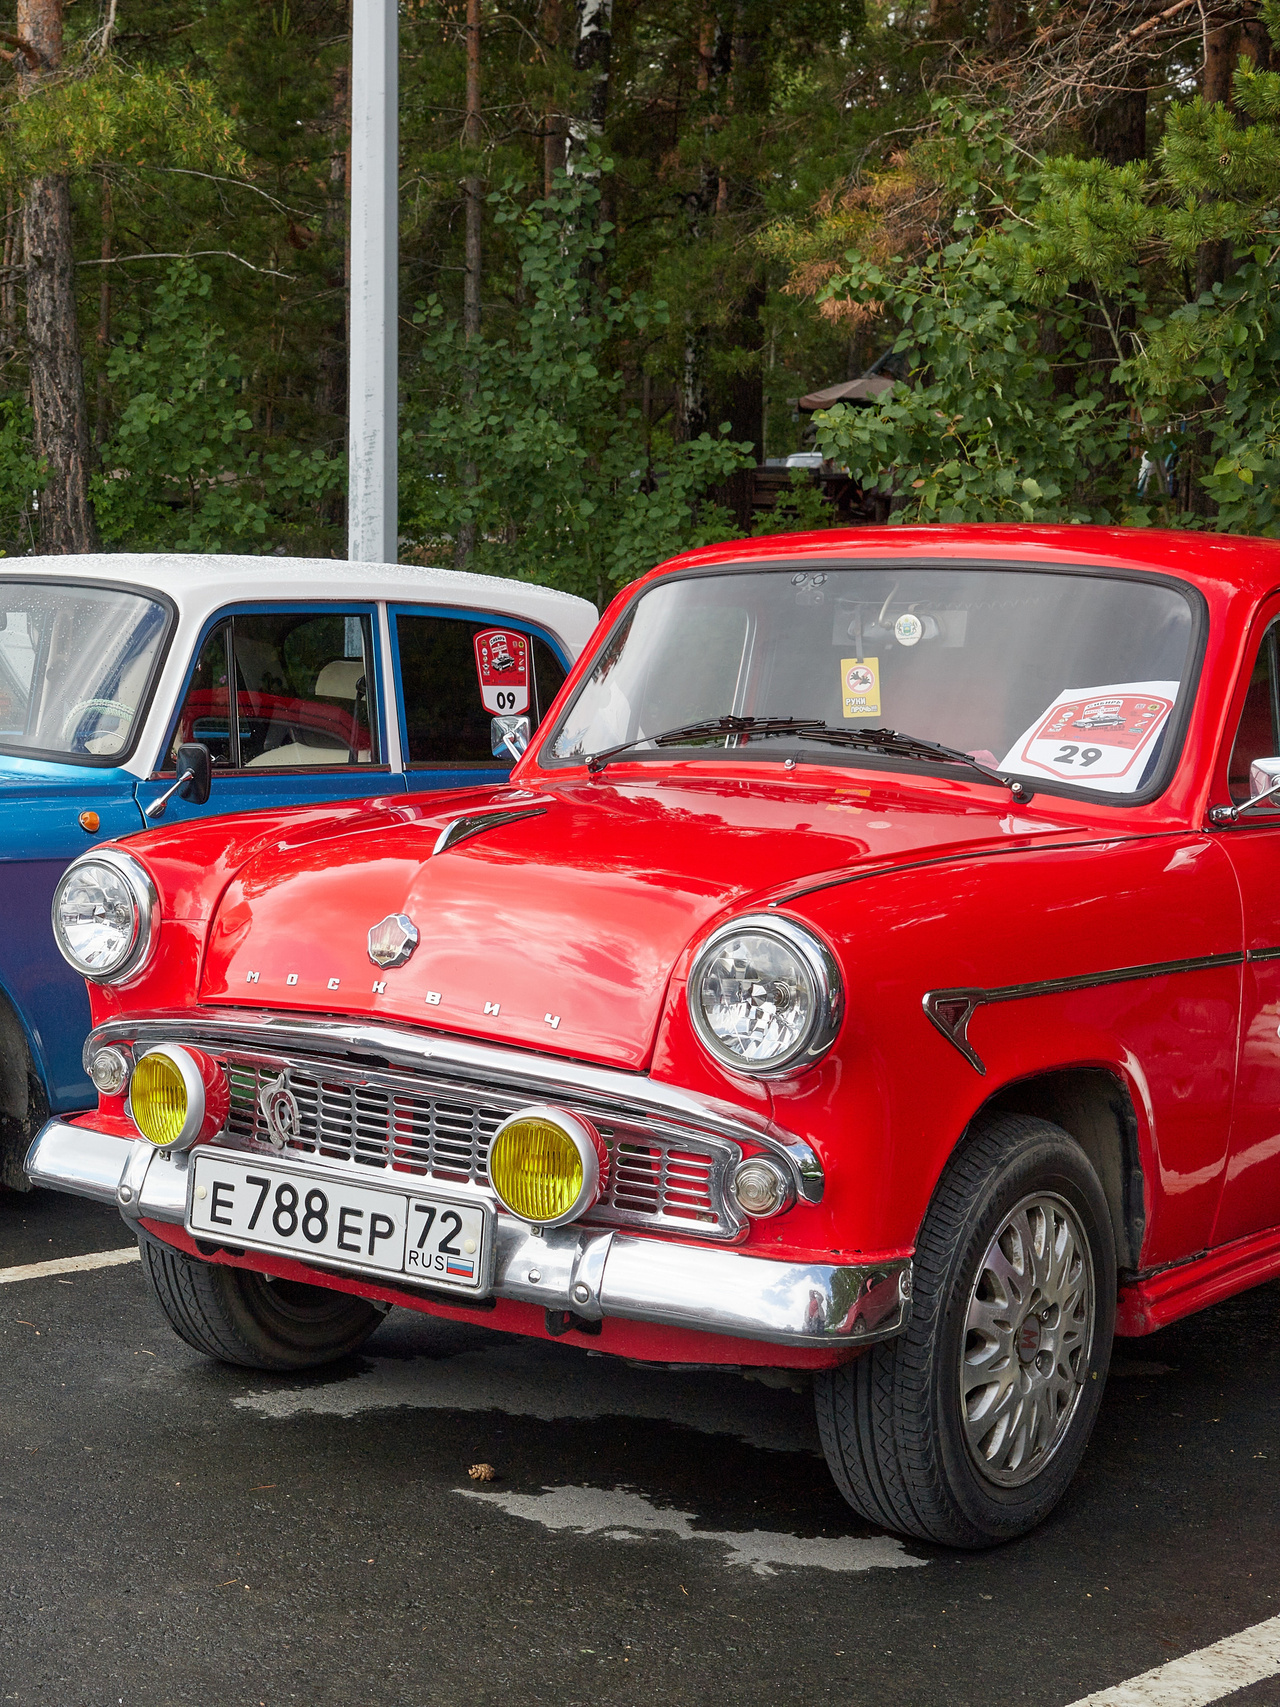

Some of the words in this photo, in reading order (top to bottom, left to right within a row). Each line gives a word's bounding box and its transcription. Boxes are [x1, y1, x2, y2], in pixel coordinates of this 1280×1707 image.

[496, 691, 516, 710] 09
[845, 697, 866, 706] РУКИ
[1053, 745, 1103, 767] 29
[246, 970, 561, 1030] МОСКВИЧ
[414, 1204, 463, 1256] 72
[408, 1249, 445, 1272] RUS
